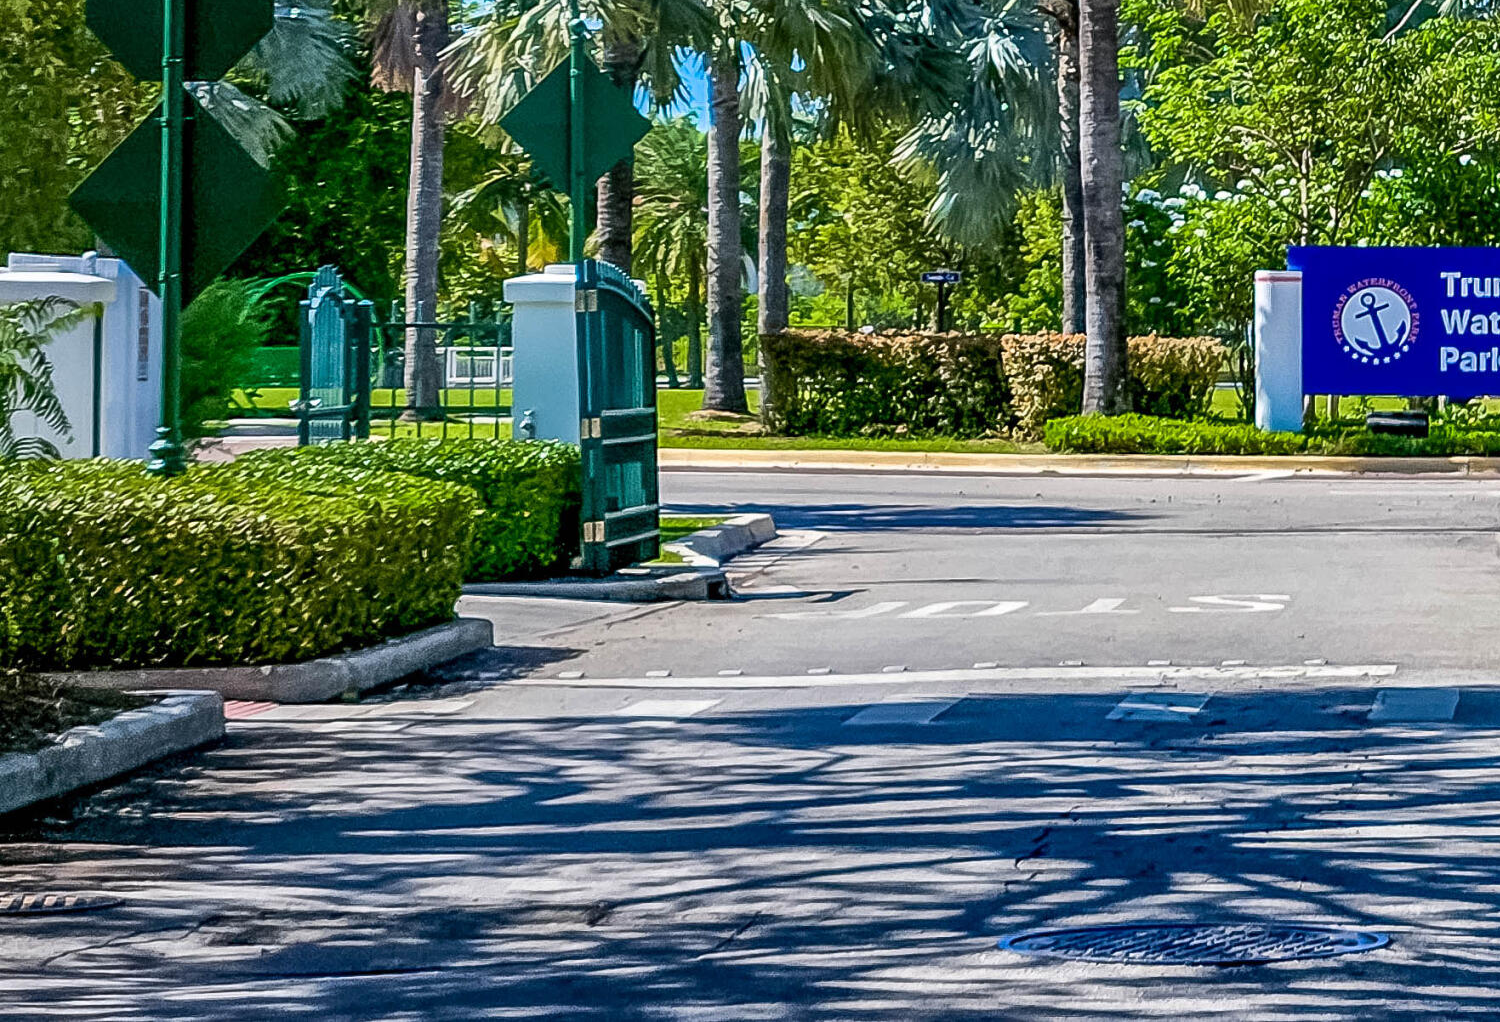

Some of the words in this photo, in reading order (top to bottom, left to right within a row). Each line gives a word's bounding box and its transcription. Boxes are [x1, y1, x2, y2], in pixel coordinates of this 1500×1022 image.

[1332, 294, 1348, 345] TRUMAN
[1347, 277, 1418, 310] WATERFRONT
[1407, 312, 1420, 344] PARK
[757, 594, 1291, 619] STOP
